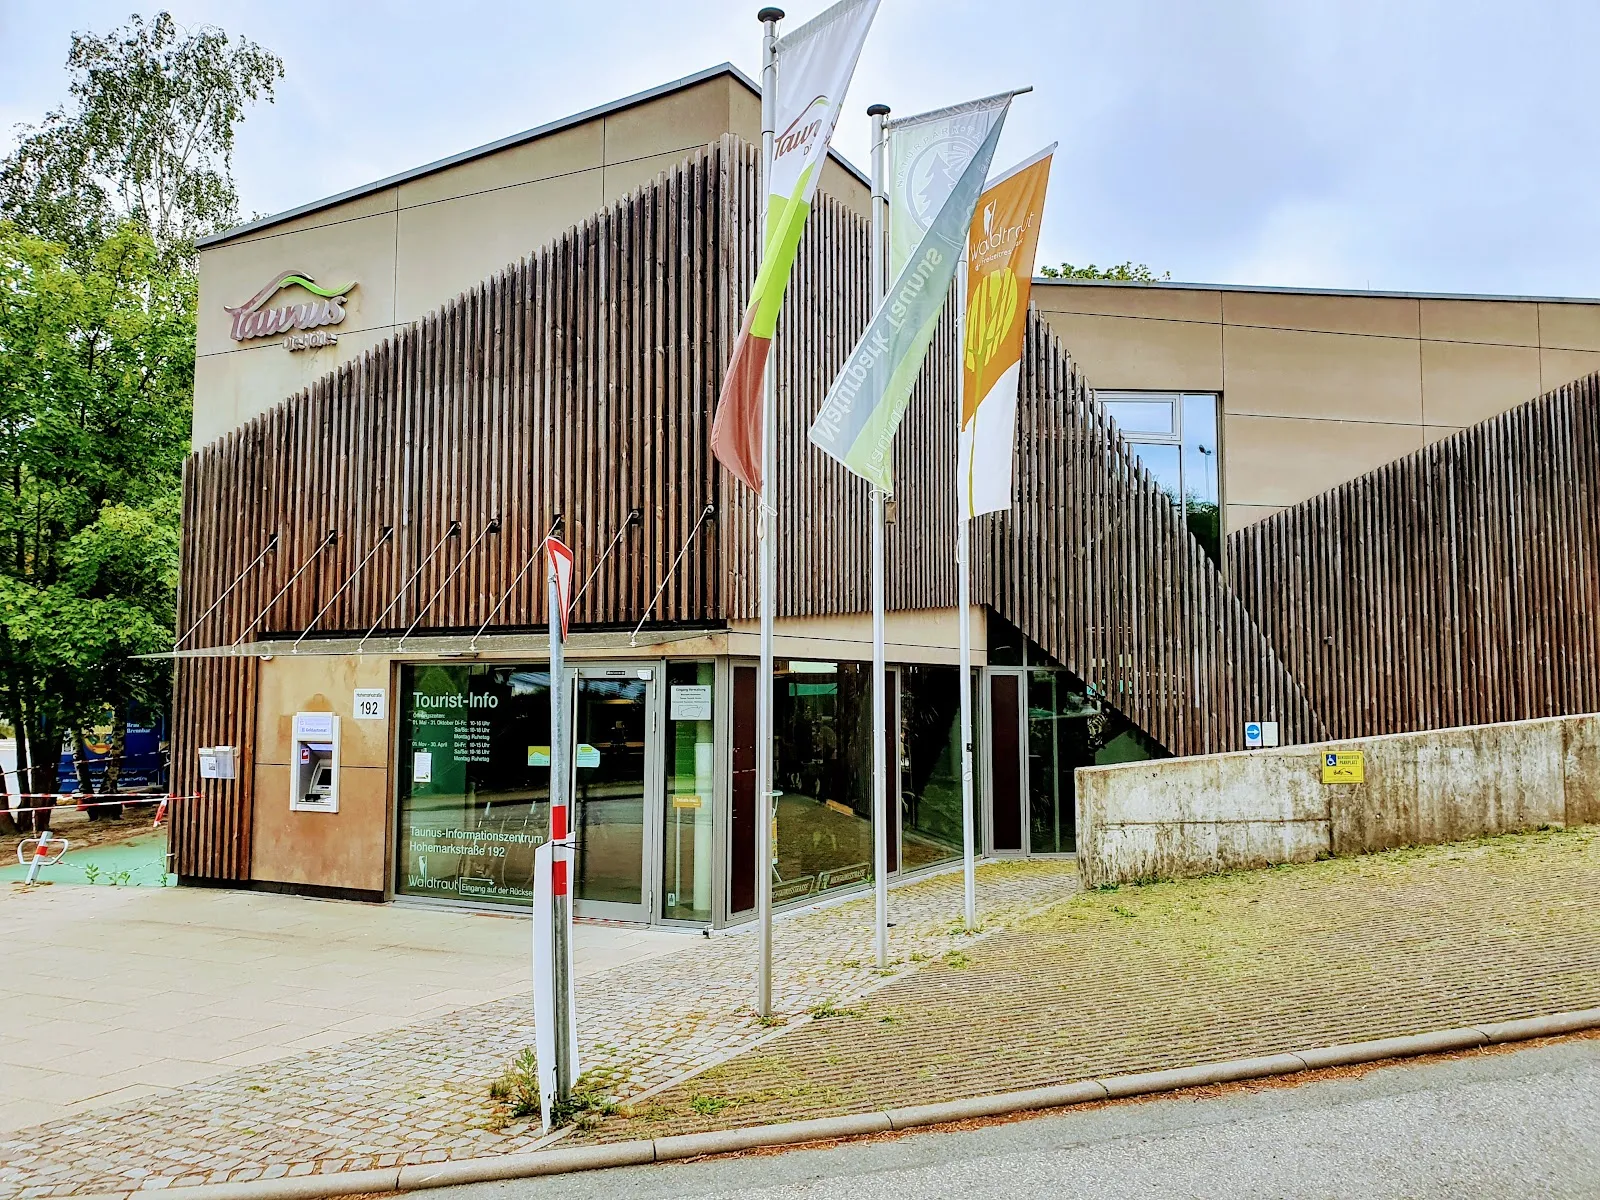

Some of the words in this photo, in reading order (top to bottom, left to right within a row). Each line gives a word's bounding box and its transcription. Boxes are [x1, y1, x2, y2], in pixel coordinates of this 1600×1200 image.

[774, 118, 823, 161] Taun
[223, 296, 348, 341] Taunus
[360, 701, 378, 715] 192
[413, 692, 498, 708] Tourist-Info
[410, 826, 543, 844] Taunus-Informationszentrum
[410, 841, 485, 856] Hohemarkstraße
[487, 846, 505, 857] 192
[461, 884, 486, 894] Eingang
[509, 887, 533, 896] Rückse
